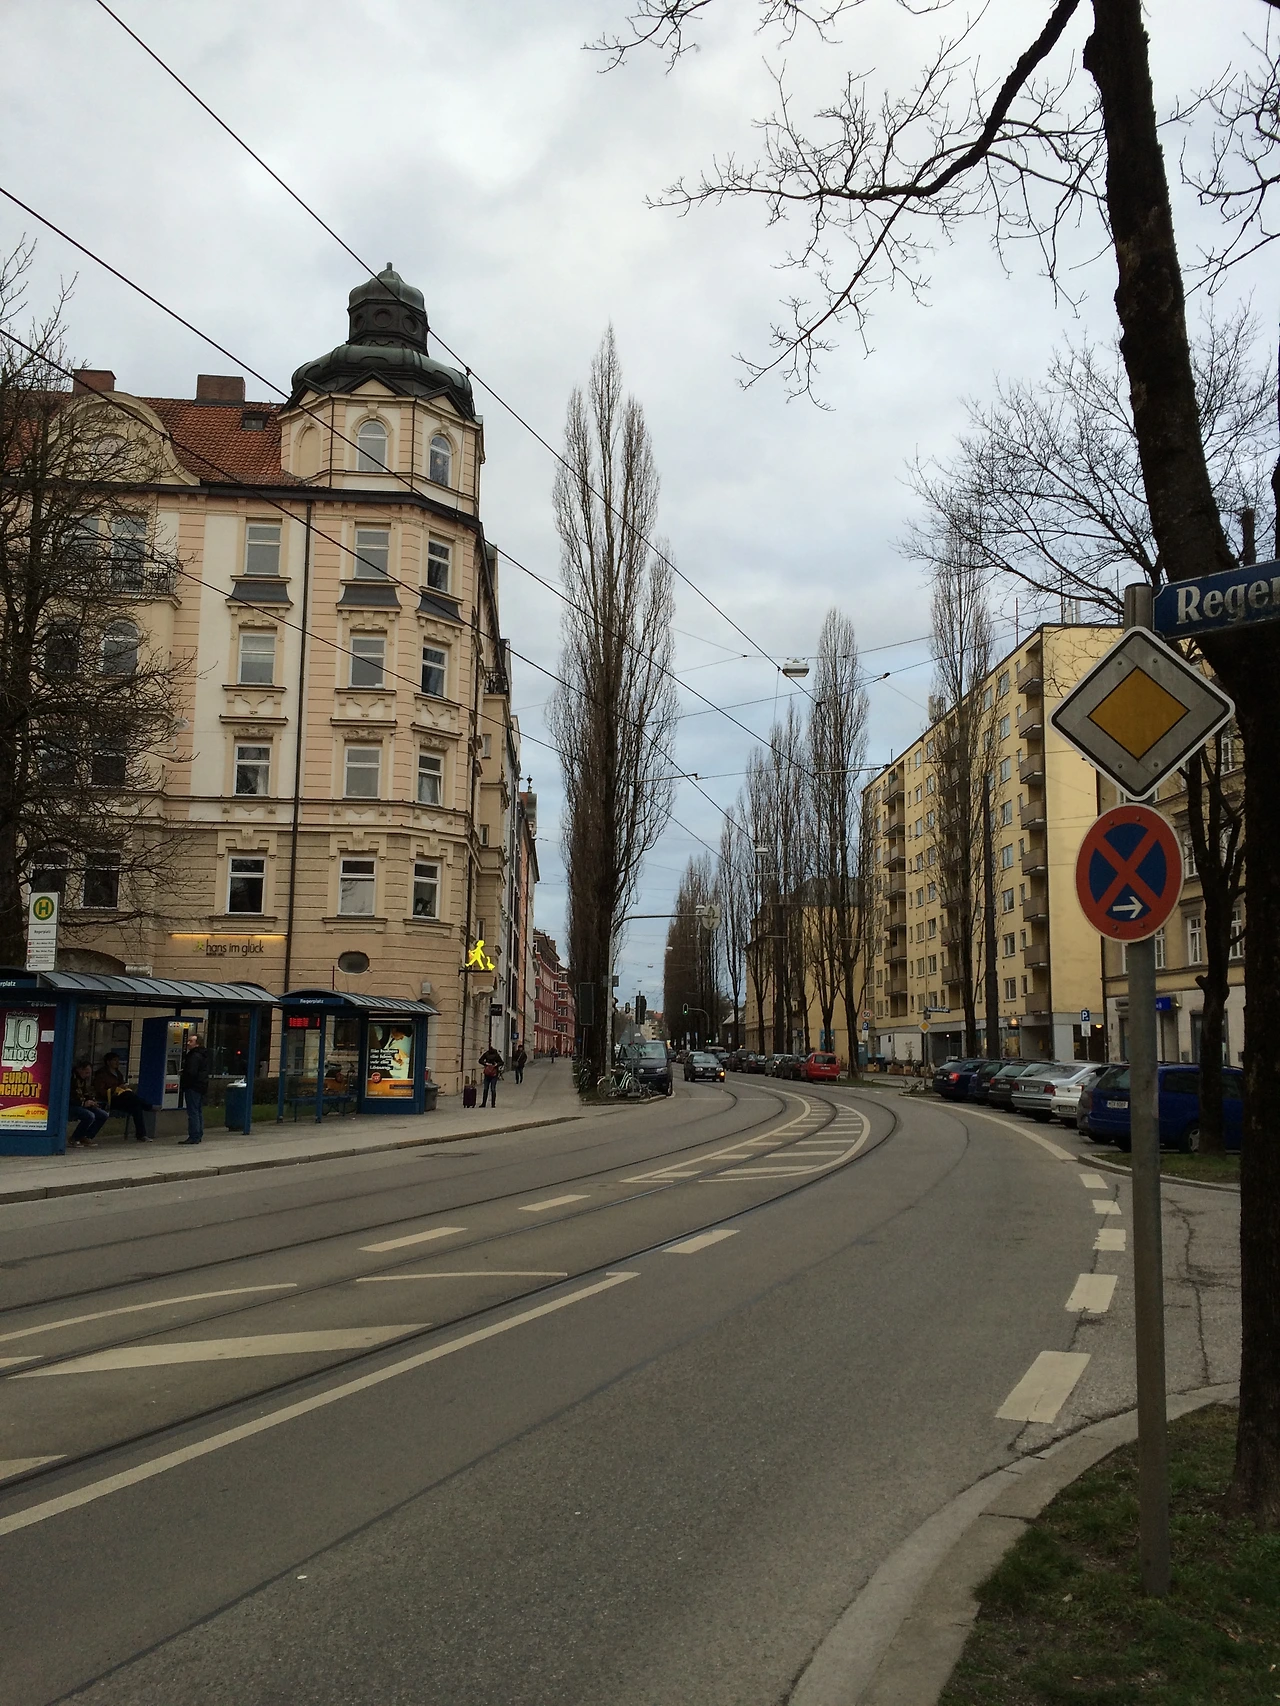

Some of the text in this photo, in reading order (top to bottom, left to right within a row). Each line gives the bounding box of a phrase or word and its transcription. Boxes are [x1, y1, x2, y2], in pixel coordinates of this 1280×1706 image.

[206, 939, 264, 957] hans im glück
[4, 1017, 39, 1049] 10
[2, 1071, 29, 1084] EURO
